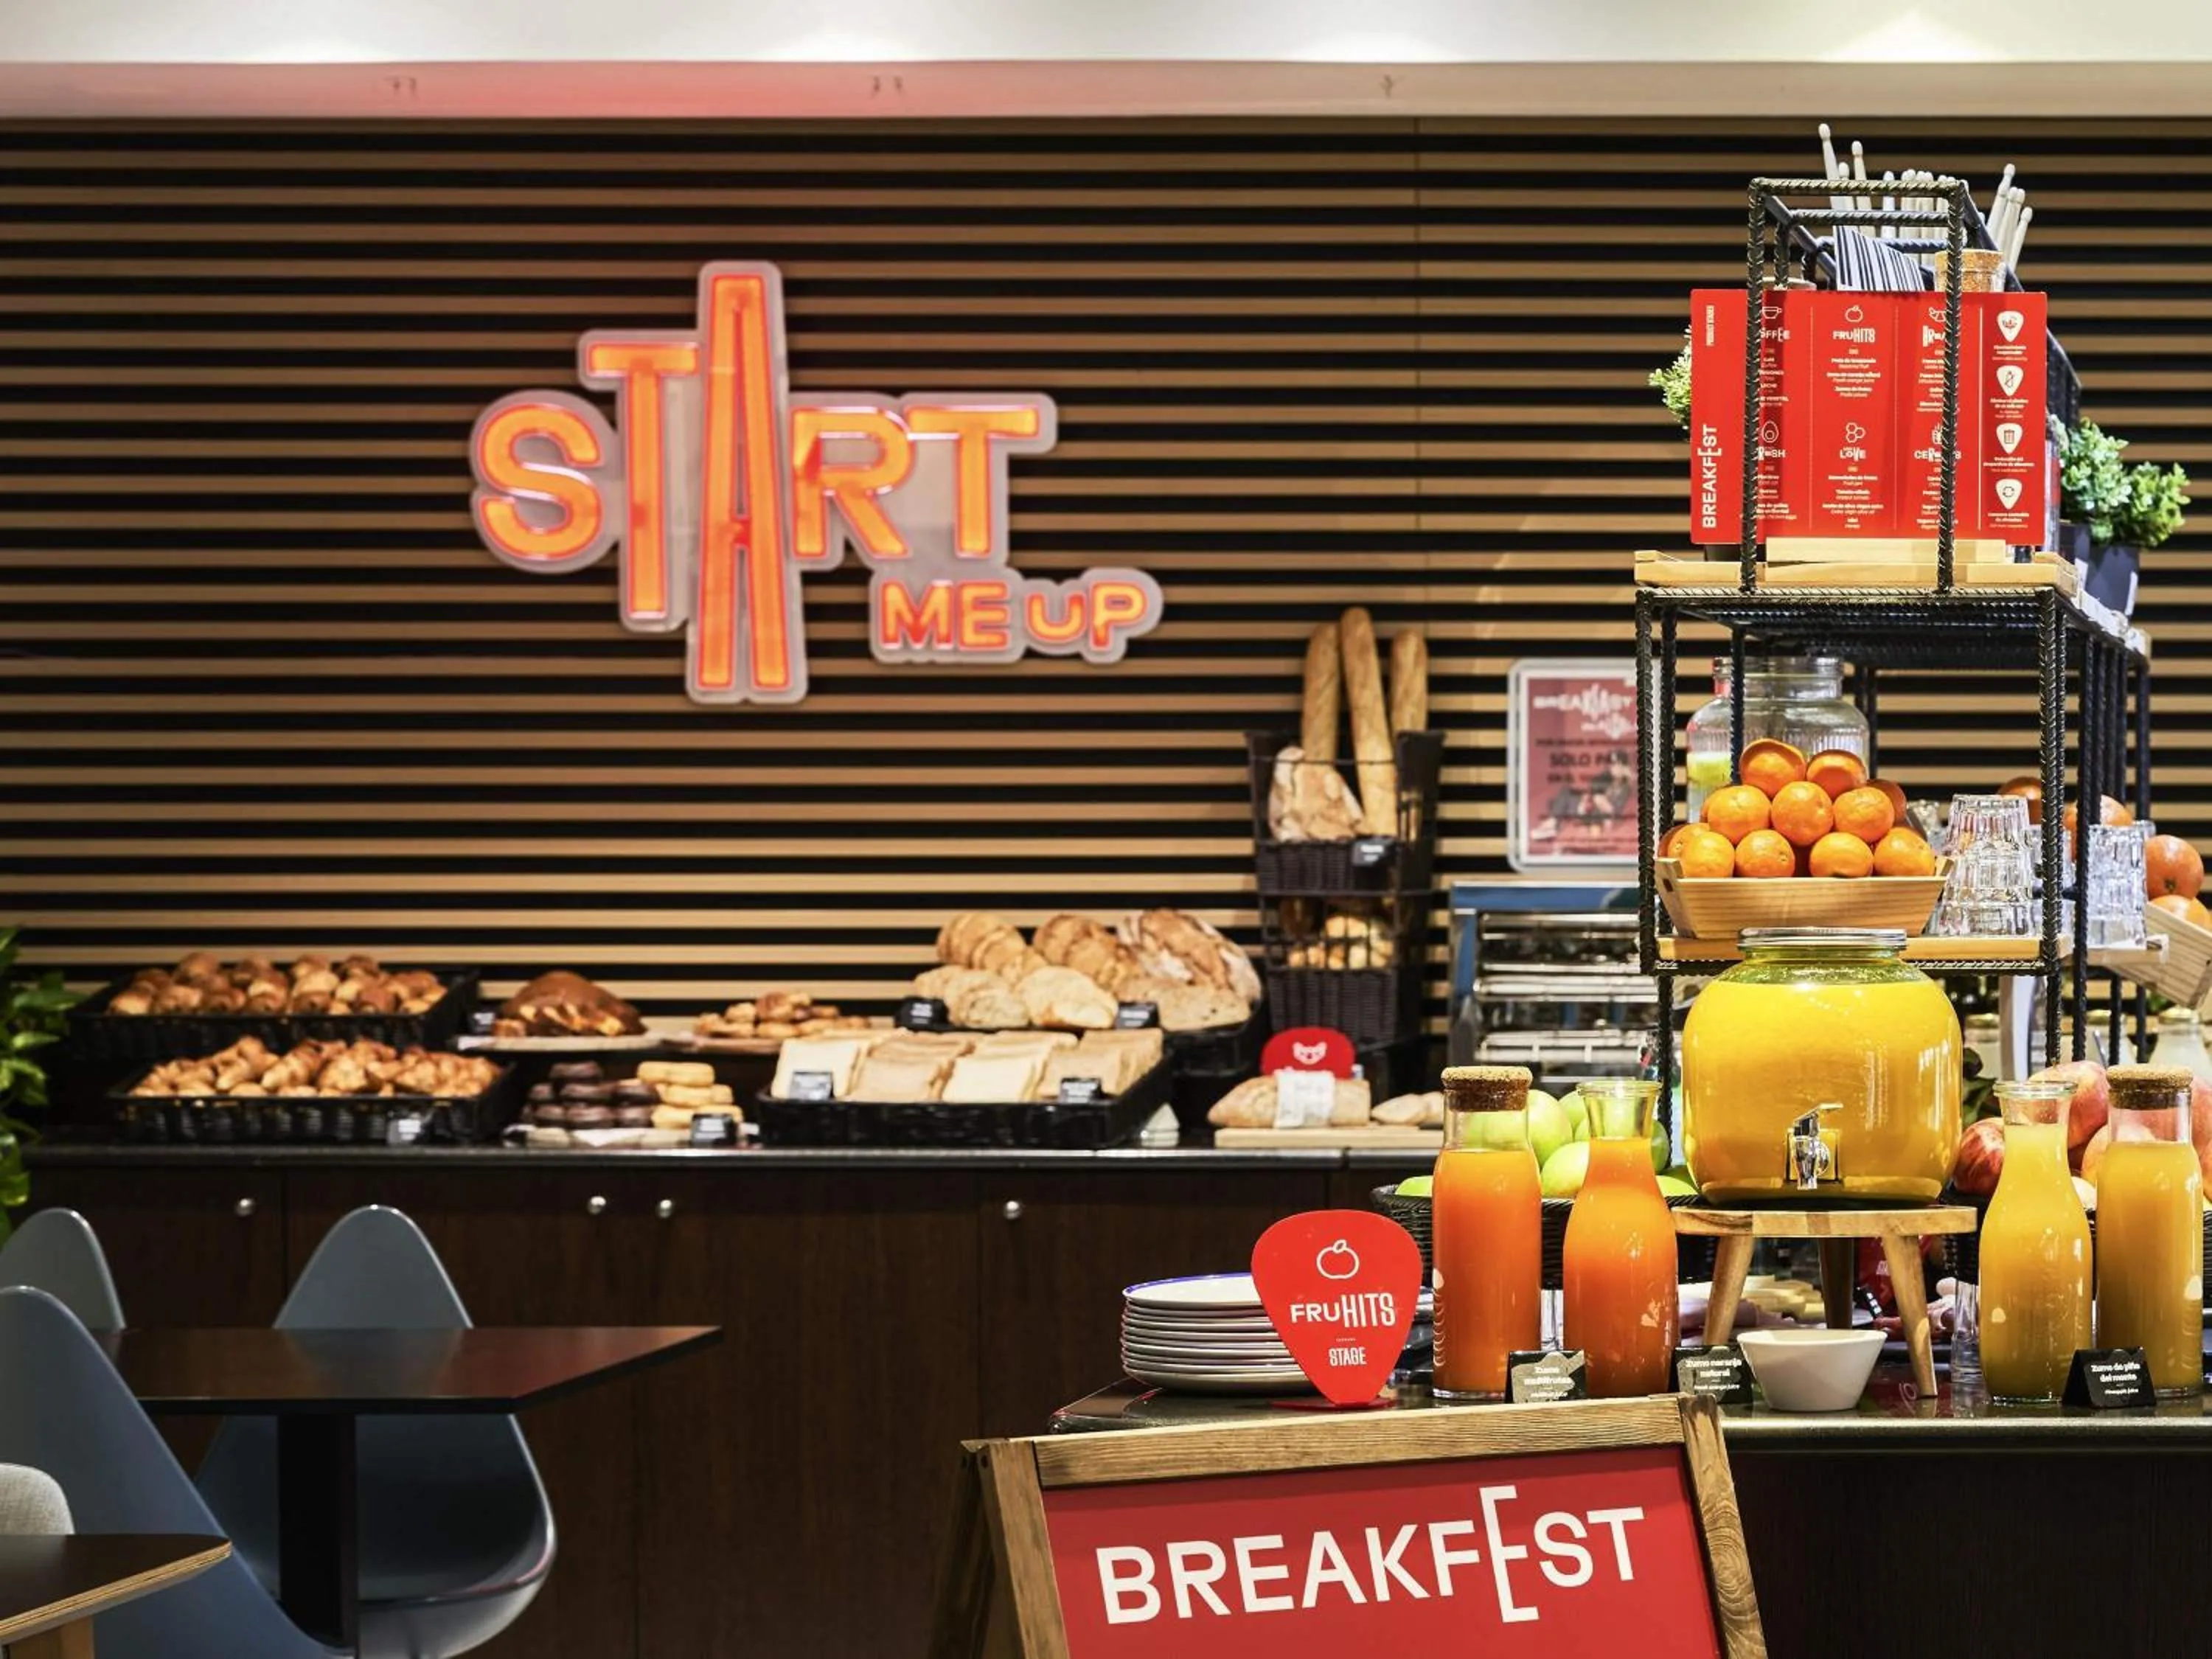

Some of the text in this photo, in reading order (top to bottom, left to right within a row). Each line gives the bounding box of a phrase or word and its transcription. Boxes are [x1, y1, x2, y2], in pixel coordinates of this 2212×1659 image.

[1832, 327, 1875, 343] FRUHITS
[478, 275, 1040, 690] START
[1702, 425, 1722, 528] BREAKFEST
[881, 580, 1147, 653] ME UP
[1290, 1293, 1396, 1328] FRUHITS
[1329, 1347, 1367, 1366] STAGE
[2091, 1364, 2113, 1372] Zumo
[2113, 1362, 2124, 1371] de
[1096, 1485, 1644, 1624] BREAKFEST
